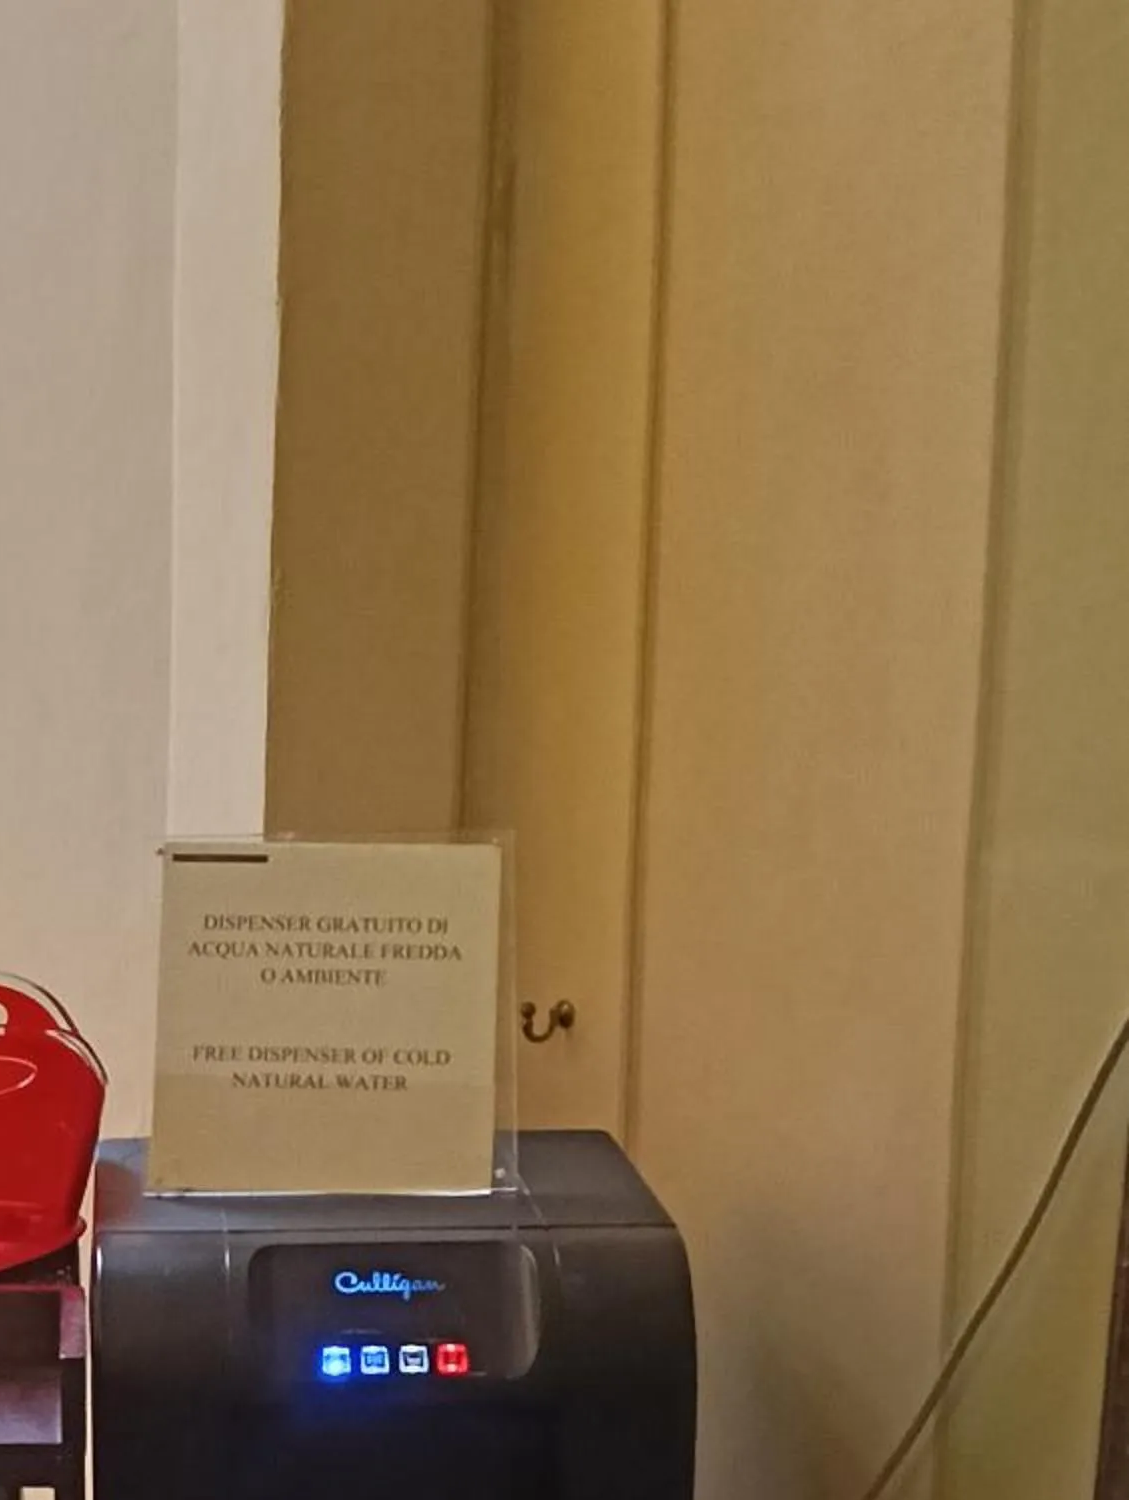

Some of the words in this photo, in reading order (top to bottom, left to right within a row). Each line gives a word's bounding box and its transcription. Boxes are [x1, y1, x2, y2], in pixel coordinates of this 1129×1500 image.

[204, 914, 310, 932] DISPENSER
[317, 916, 421, 934] GRATUITO
[427, 917, 448, 934] DI
[188, 941, 258, 959] ACQUA
[265, 942, 373, 959] NATURALE
[381, 944, 462, 960] FREDDA
[261, 968, 276, 984] O
[281, 969, 387, 986] AMBIENTE
[192, 1045, 242, 1062] FREE
[248, 1046, 356, 1064] DISPENSER
[362, 1048, 388, 1065] OF
[393, 1048, 451, 1066] COLD
[232, 1073, 330, 1089] NATURAL
[336, 1074, 408, 1091] WATER
[334, 1270, 446, 1301] Culligan
